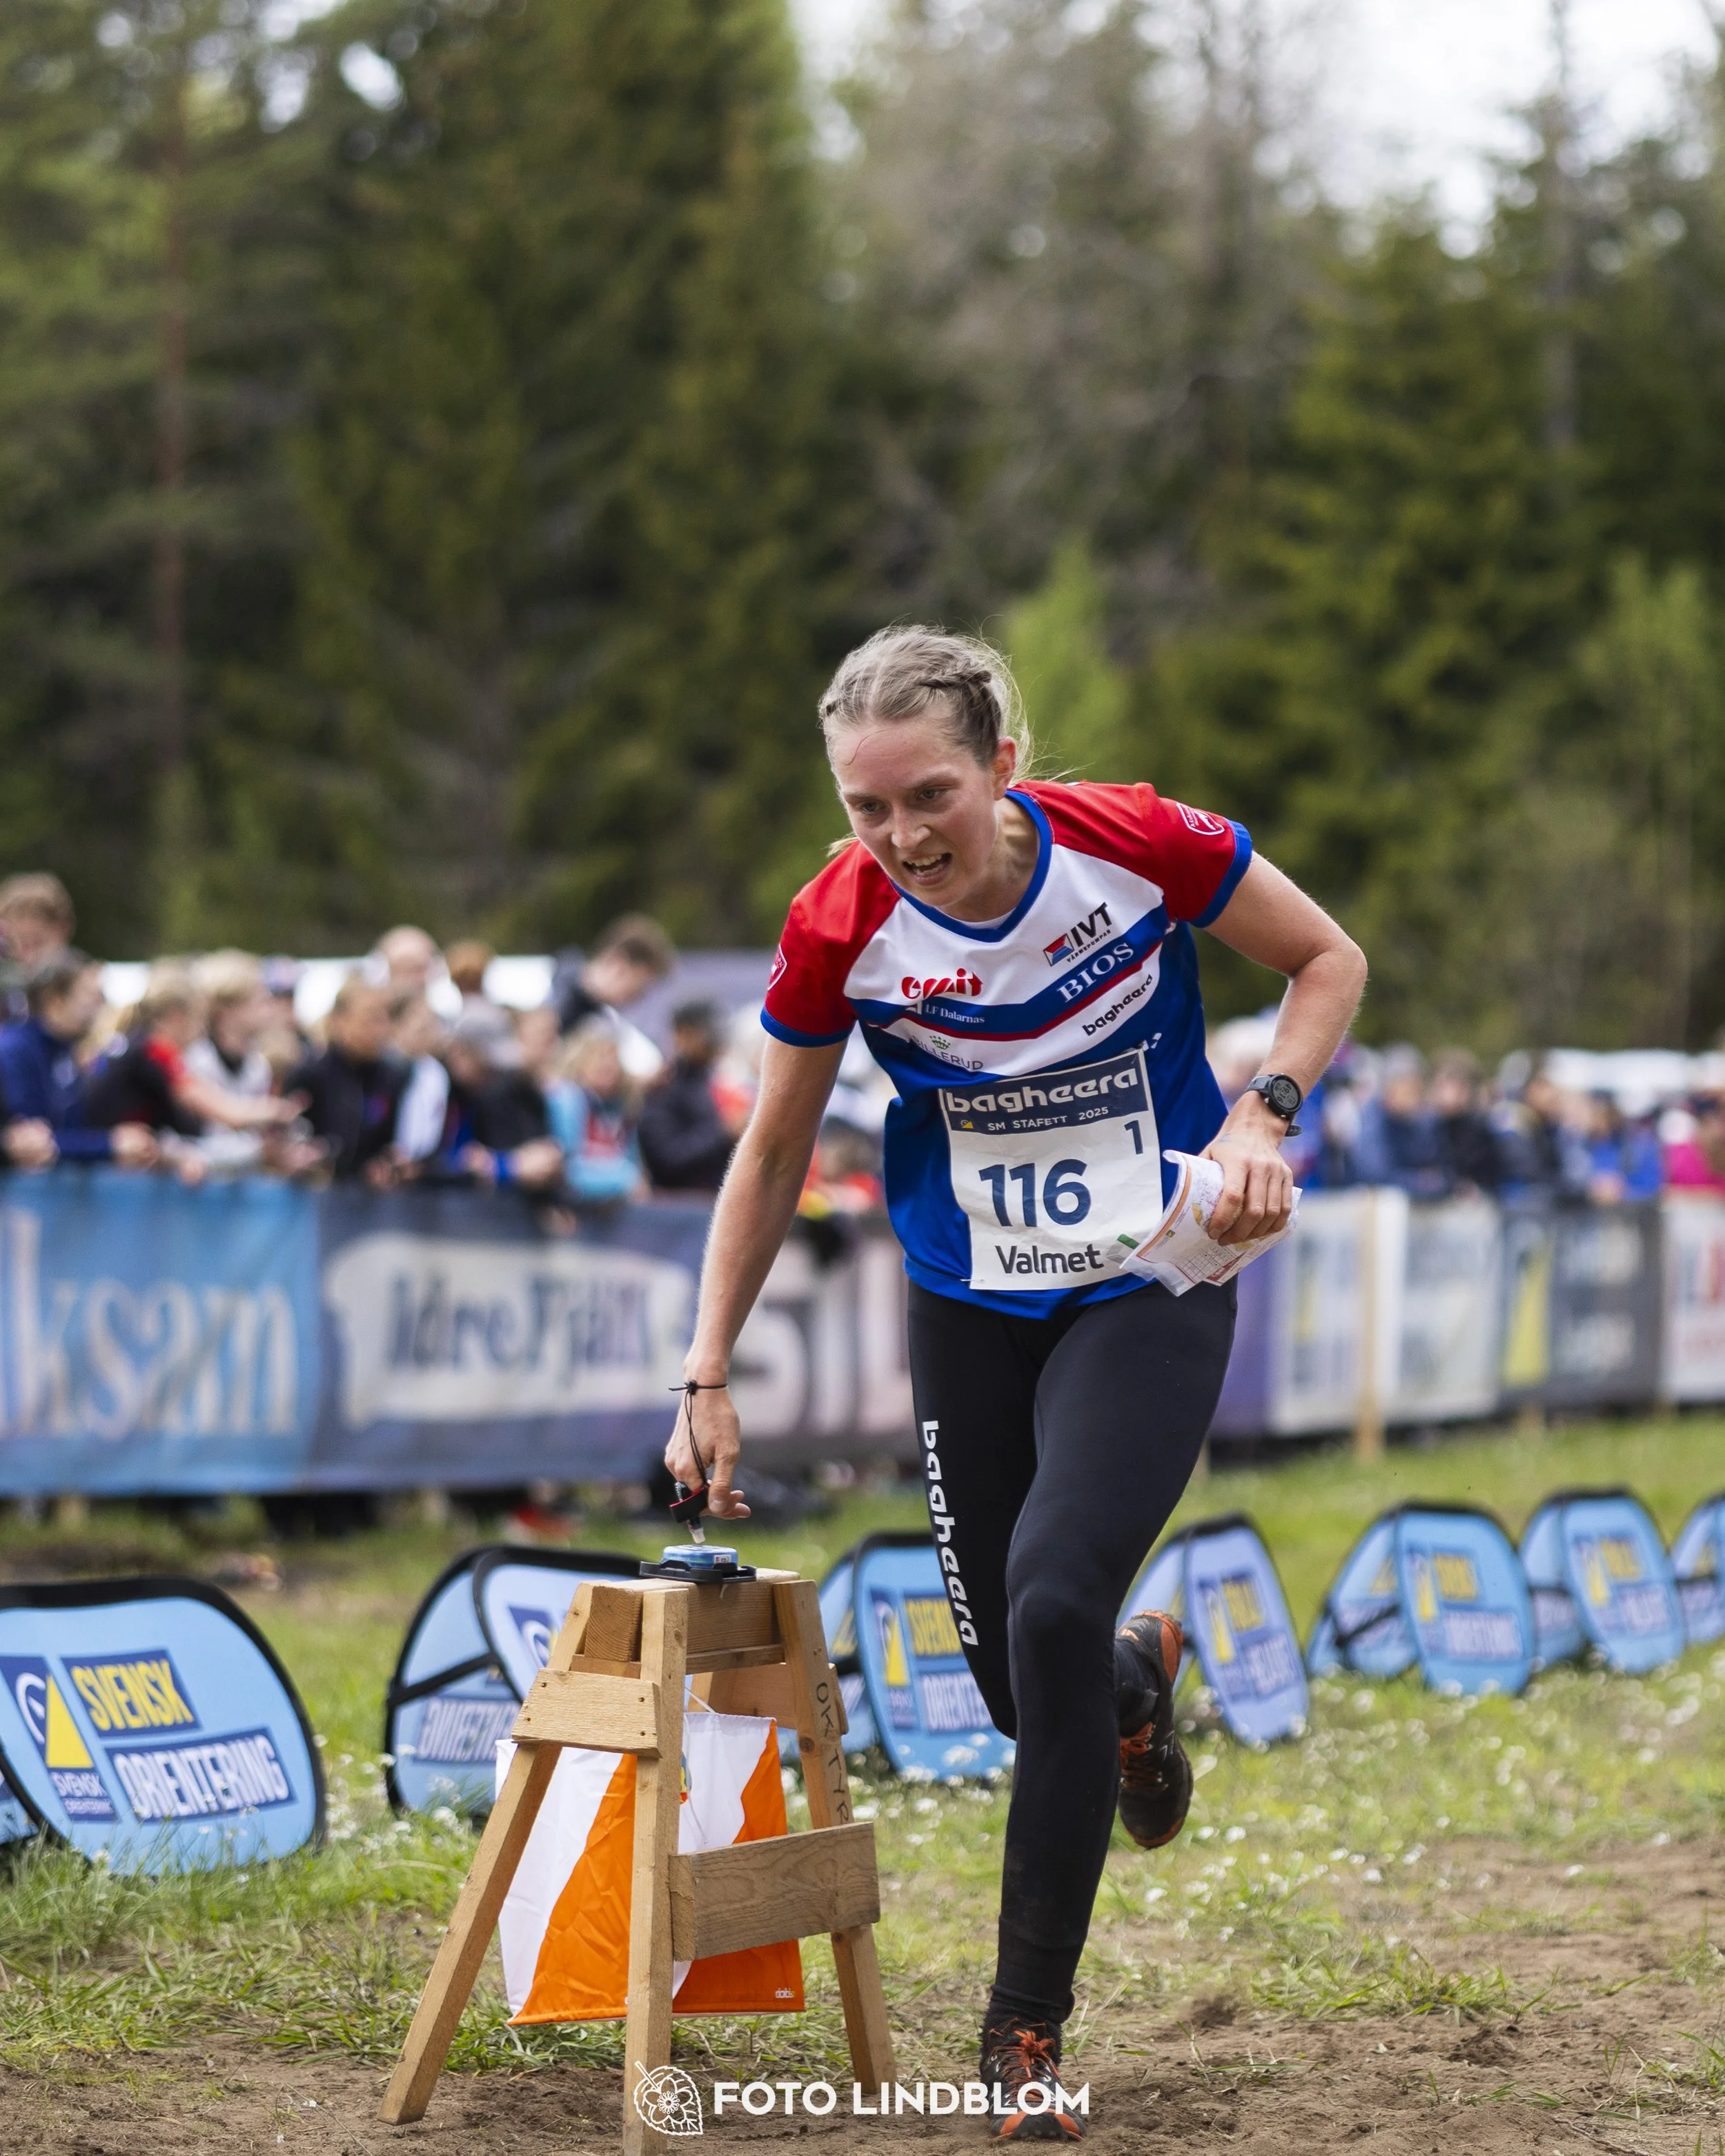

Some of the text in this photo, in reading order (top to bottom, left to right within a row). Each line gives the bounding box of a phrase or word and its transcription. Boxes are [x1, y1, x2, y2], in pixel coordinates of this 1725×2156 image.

[1070, 902, 1112, 947] IVT
[901, 968, 984, 999] emit
[1056, 942, 1134, 1002] BIOS
[925, 1003, 985, 1023] LF Dalarnas
[1082, 974, 1153, 1036] bagheera
[947, 1068, 1138, 1113] bagheera
[987, 1107, 1109, 1131] SM STAFETT 2025
[1124, 1120, 1143, 1155] 1
[978, 1158, 1092, 1227] 116
[995, 1244, 1105, 1274] Valmet
[0, 1206, 299, 1438] ksam
[923, 1420, 978, 1645] bagheera
[72, 1658, 195, 1731] SVENSK
[816, 1682, 834, 1738] OK
[113, 1734, 290, 1819] ORIENTERING
